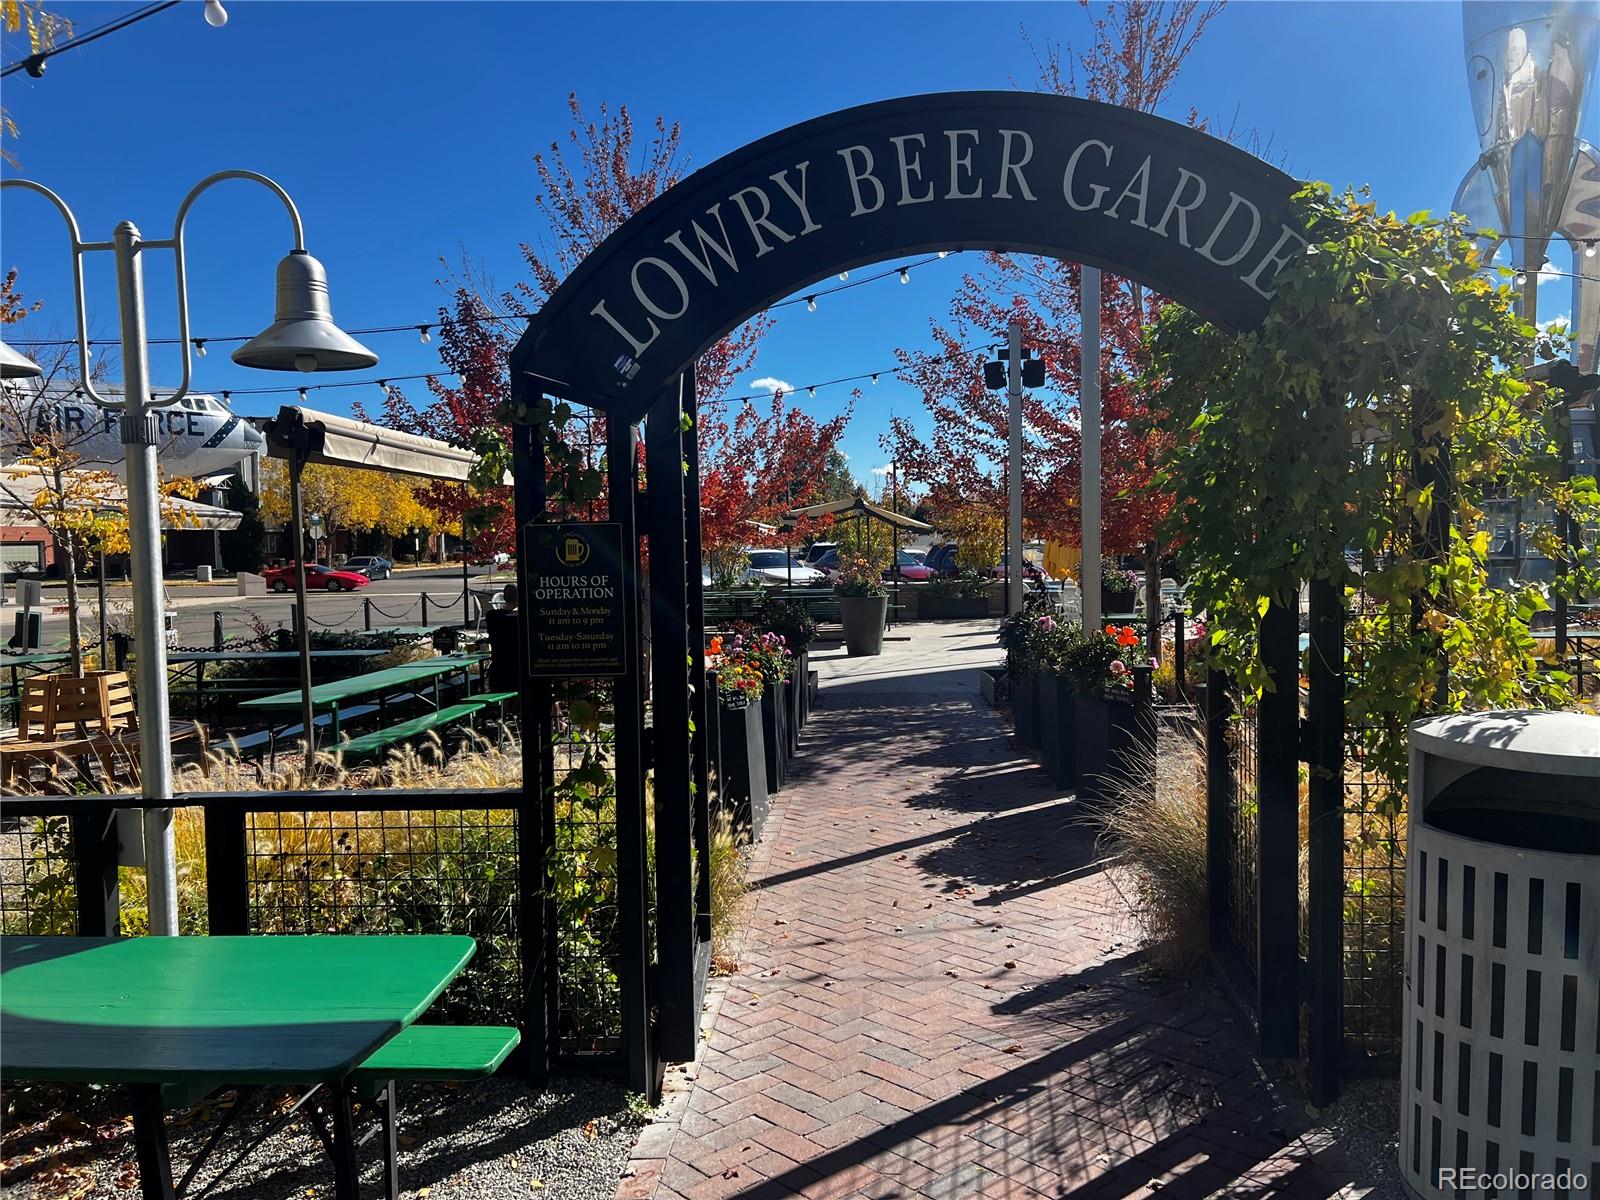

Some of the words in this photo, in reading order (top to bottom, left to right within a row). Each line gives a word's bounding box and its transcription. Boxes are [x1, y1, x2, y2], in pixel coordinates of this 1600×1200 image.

[590, 160, 823, 358] LOWRY
[836, 128, 1038, 217] BEER
[1063, 138, 1309, 301] GARDE
[539, 575, 588, 588] HOURS
[590, 575, 609, 587] OF
[535, 587, 614, 600] OPERATION
[557, 617, 570, 625] am
[590, 617, 604, 626] pm
[592, 642, 607, 652] pm
